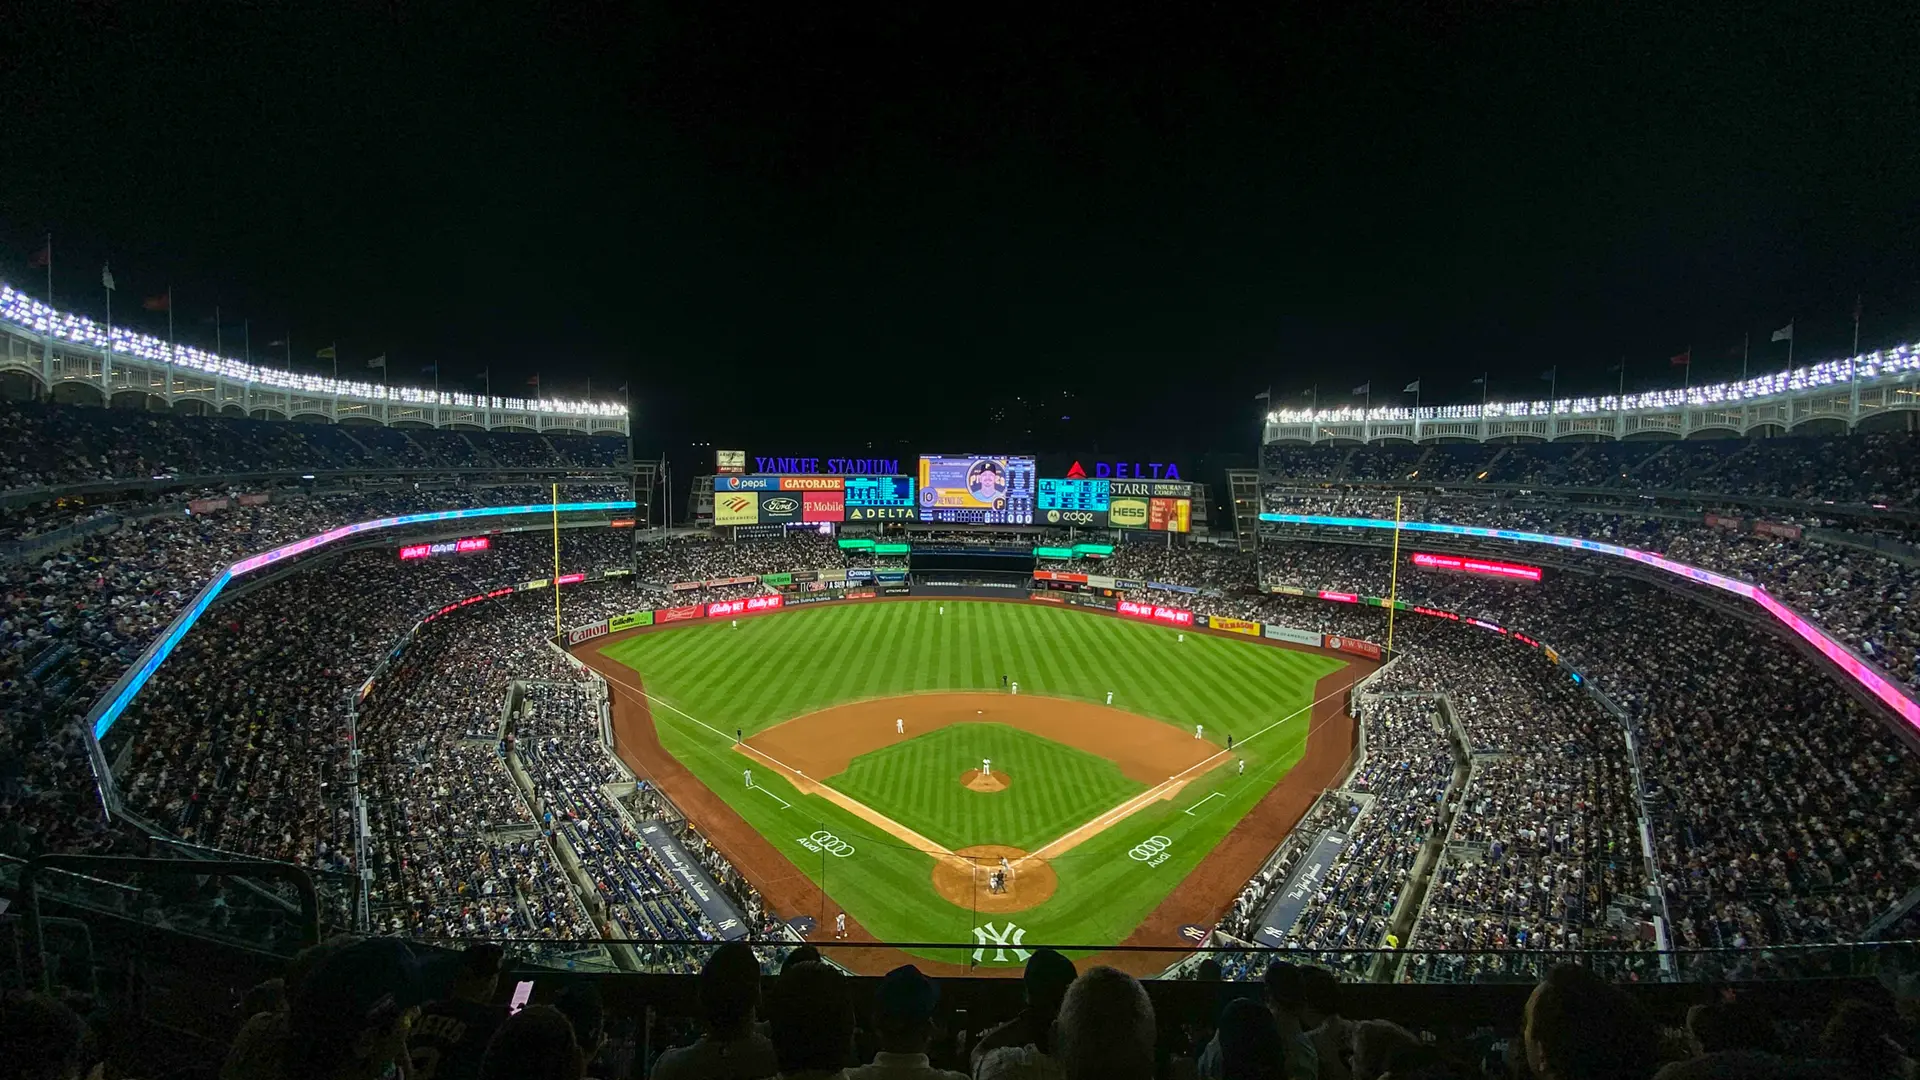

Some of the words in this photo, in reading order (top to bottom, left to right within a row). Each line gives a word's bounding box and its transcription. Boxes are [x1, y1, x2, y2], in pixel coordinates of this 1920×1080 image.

[755, 457, 819, 474] YANKEE
[827, 459, 898, 475] STADIUM
[1096, 462, 1181, 480] DELTA
[741, 479, 768, 488] pepsi
[784, 479, 841, 488] GATORADE
[1110, 483, 1150, 495] STARR
[768, 500, 793, 511] Ford
[813, 501, 844, 512] Mobile
[866, 508, 915, 518] DELTA
[1062, 510, 1093, 525] edge
[1112, 507, 1145, 518] HESS
[710, 603, 732, 614] Bally
[732, 602, 744, 611] BET
[748, 599, 768, 609] Bally
[768, 597, 779, 606] BET
[1120, 601, 1140, 614] Bally
[1141, 606, 1152, 616] BET
[1154, 607, 1176, 620] Bally
[1176, 612, 1188, 621] BET
[612, 617, 635, 626] Gillette
[570, 624, 607, 642] Canon
[796, 837, 822, 853] Audi
[1147, 851, 1172, 868] Audi
[972, 921, 1032, 962] NY
